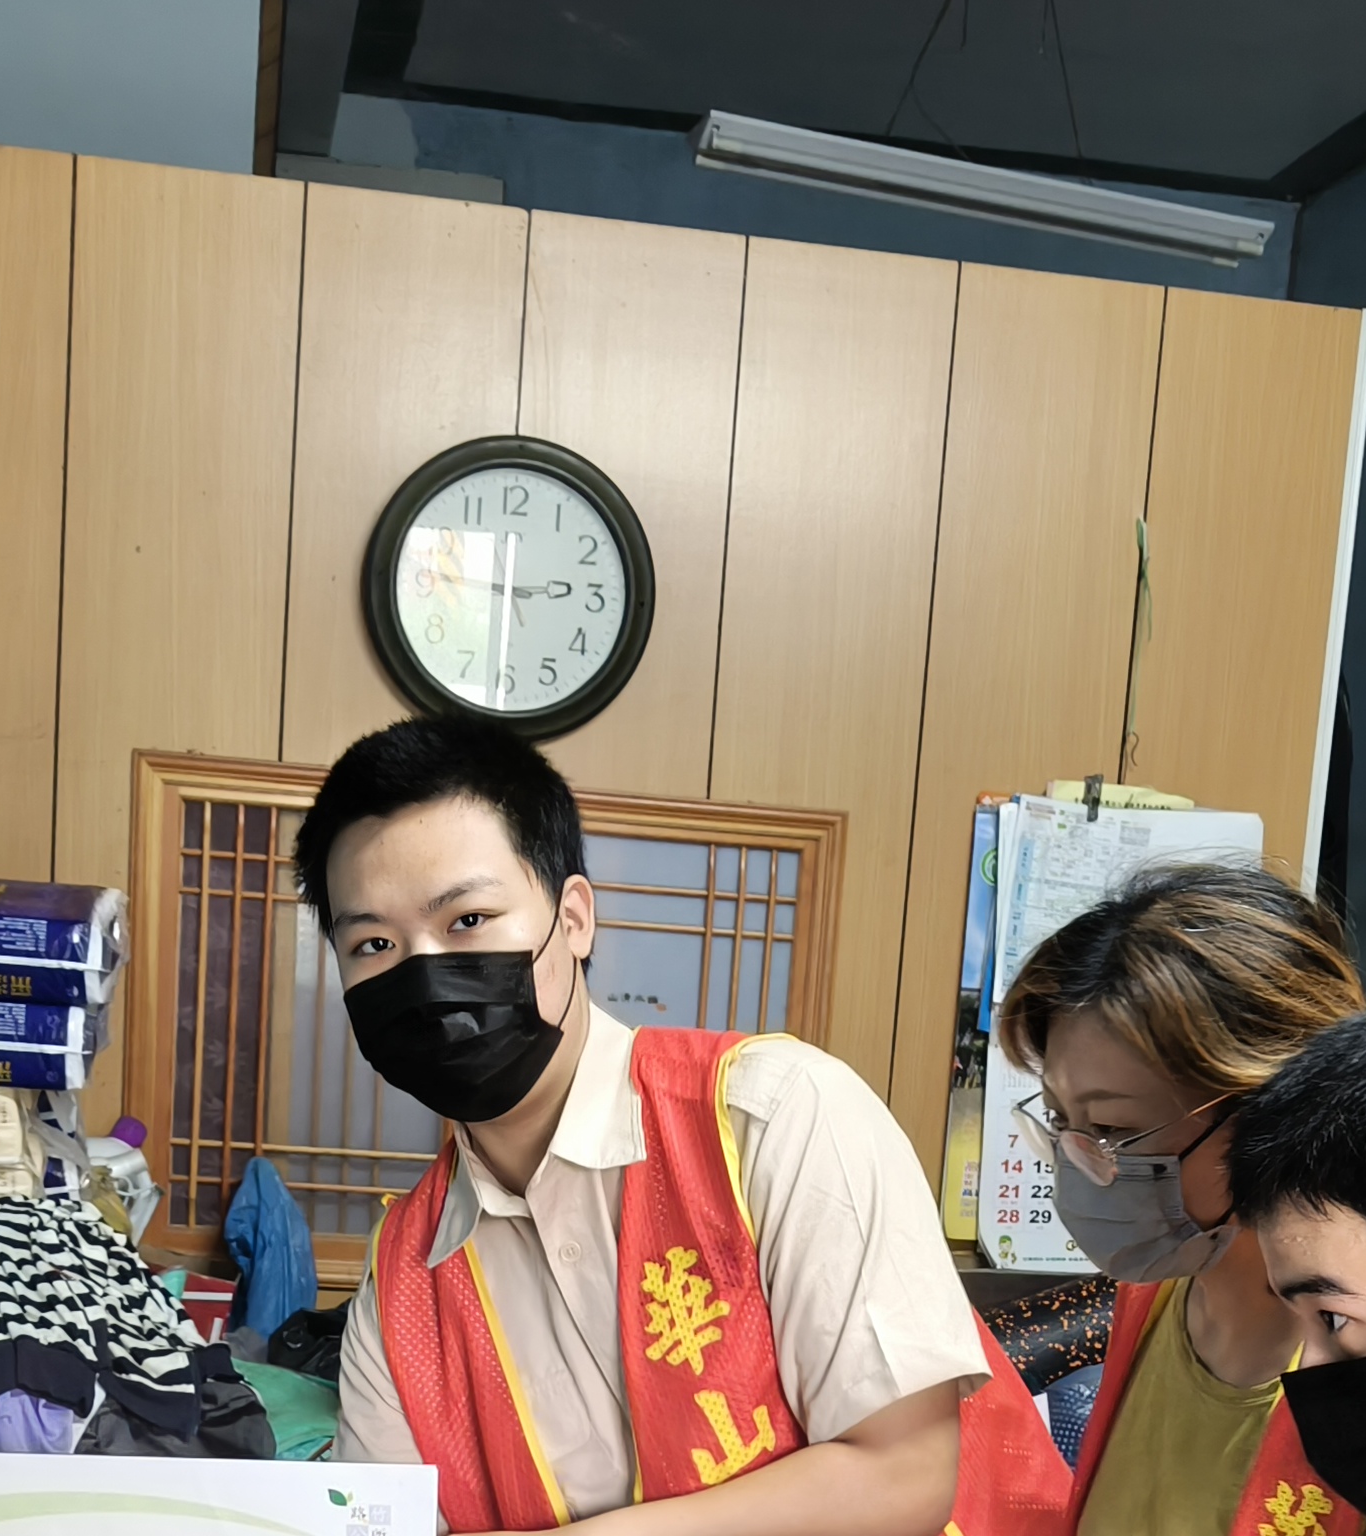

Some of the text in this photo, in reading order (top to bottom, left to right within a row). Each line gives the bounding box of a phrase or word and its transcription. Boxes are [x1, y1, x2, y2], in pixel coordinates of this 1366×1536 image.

[463, 495, 483, 526] 11
[502, 485, 530, 517] 12
[554, 503, 563, 533] 1
[578, 535, 599, 566] 2
[585, 584, 606, 613] 3
[424, 613, 446, 644] 8
[568, 627, 588, 656] 4
[456, 650, 476, 680] 7
[496, 665, 516, 695] 6
[538, 658, 559, 686] 5
[1008, 1134, 1019, 1148] 7
[1000, 1159, 1024, 1174] 14
[998, 1184, 1054, 1199] 21 22
[997, 1209, 1052, 1224] 28 29
[640, 1246, 776, 1486] 華山
